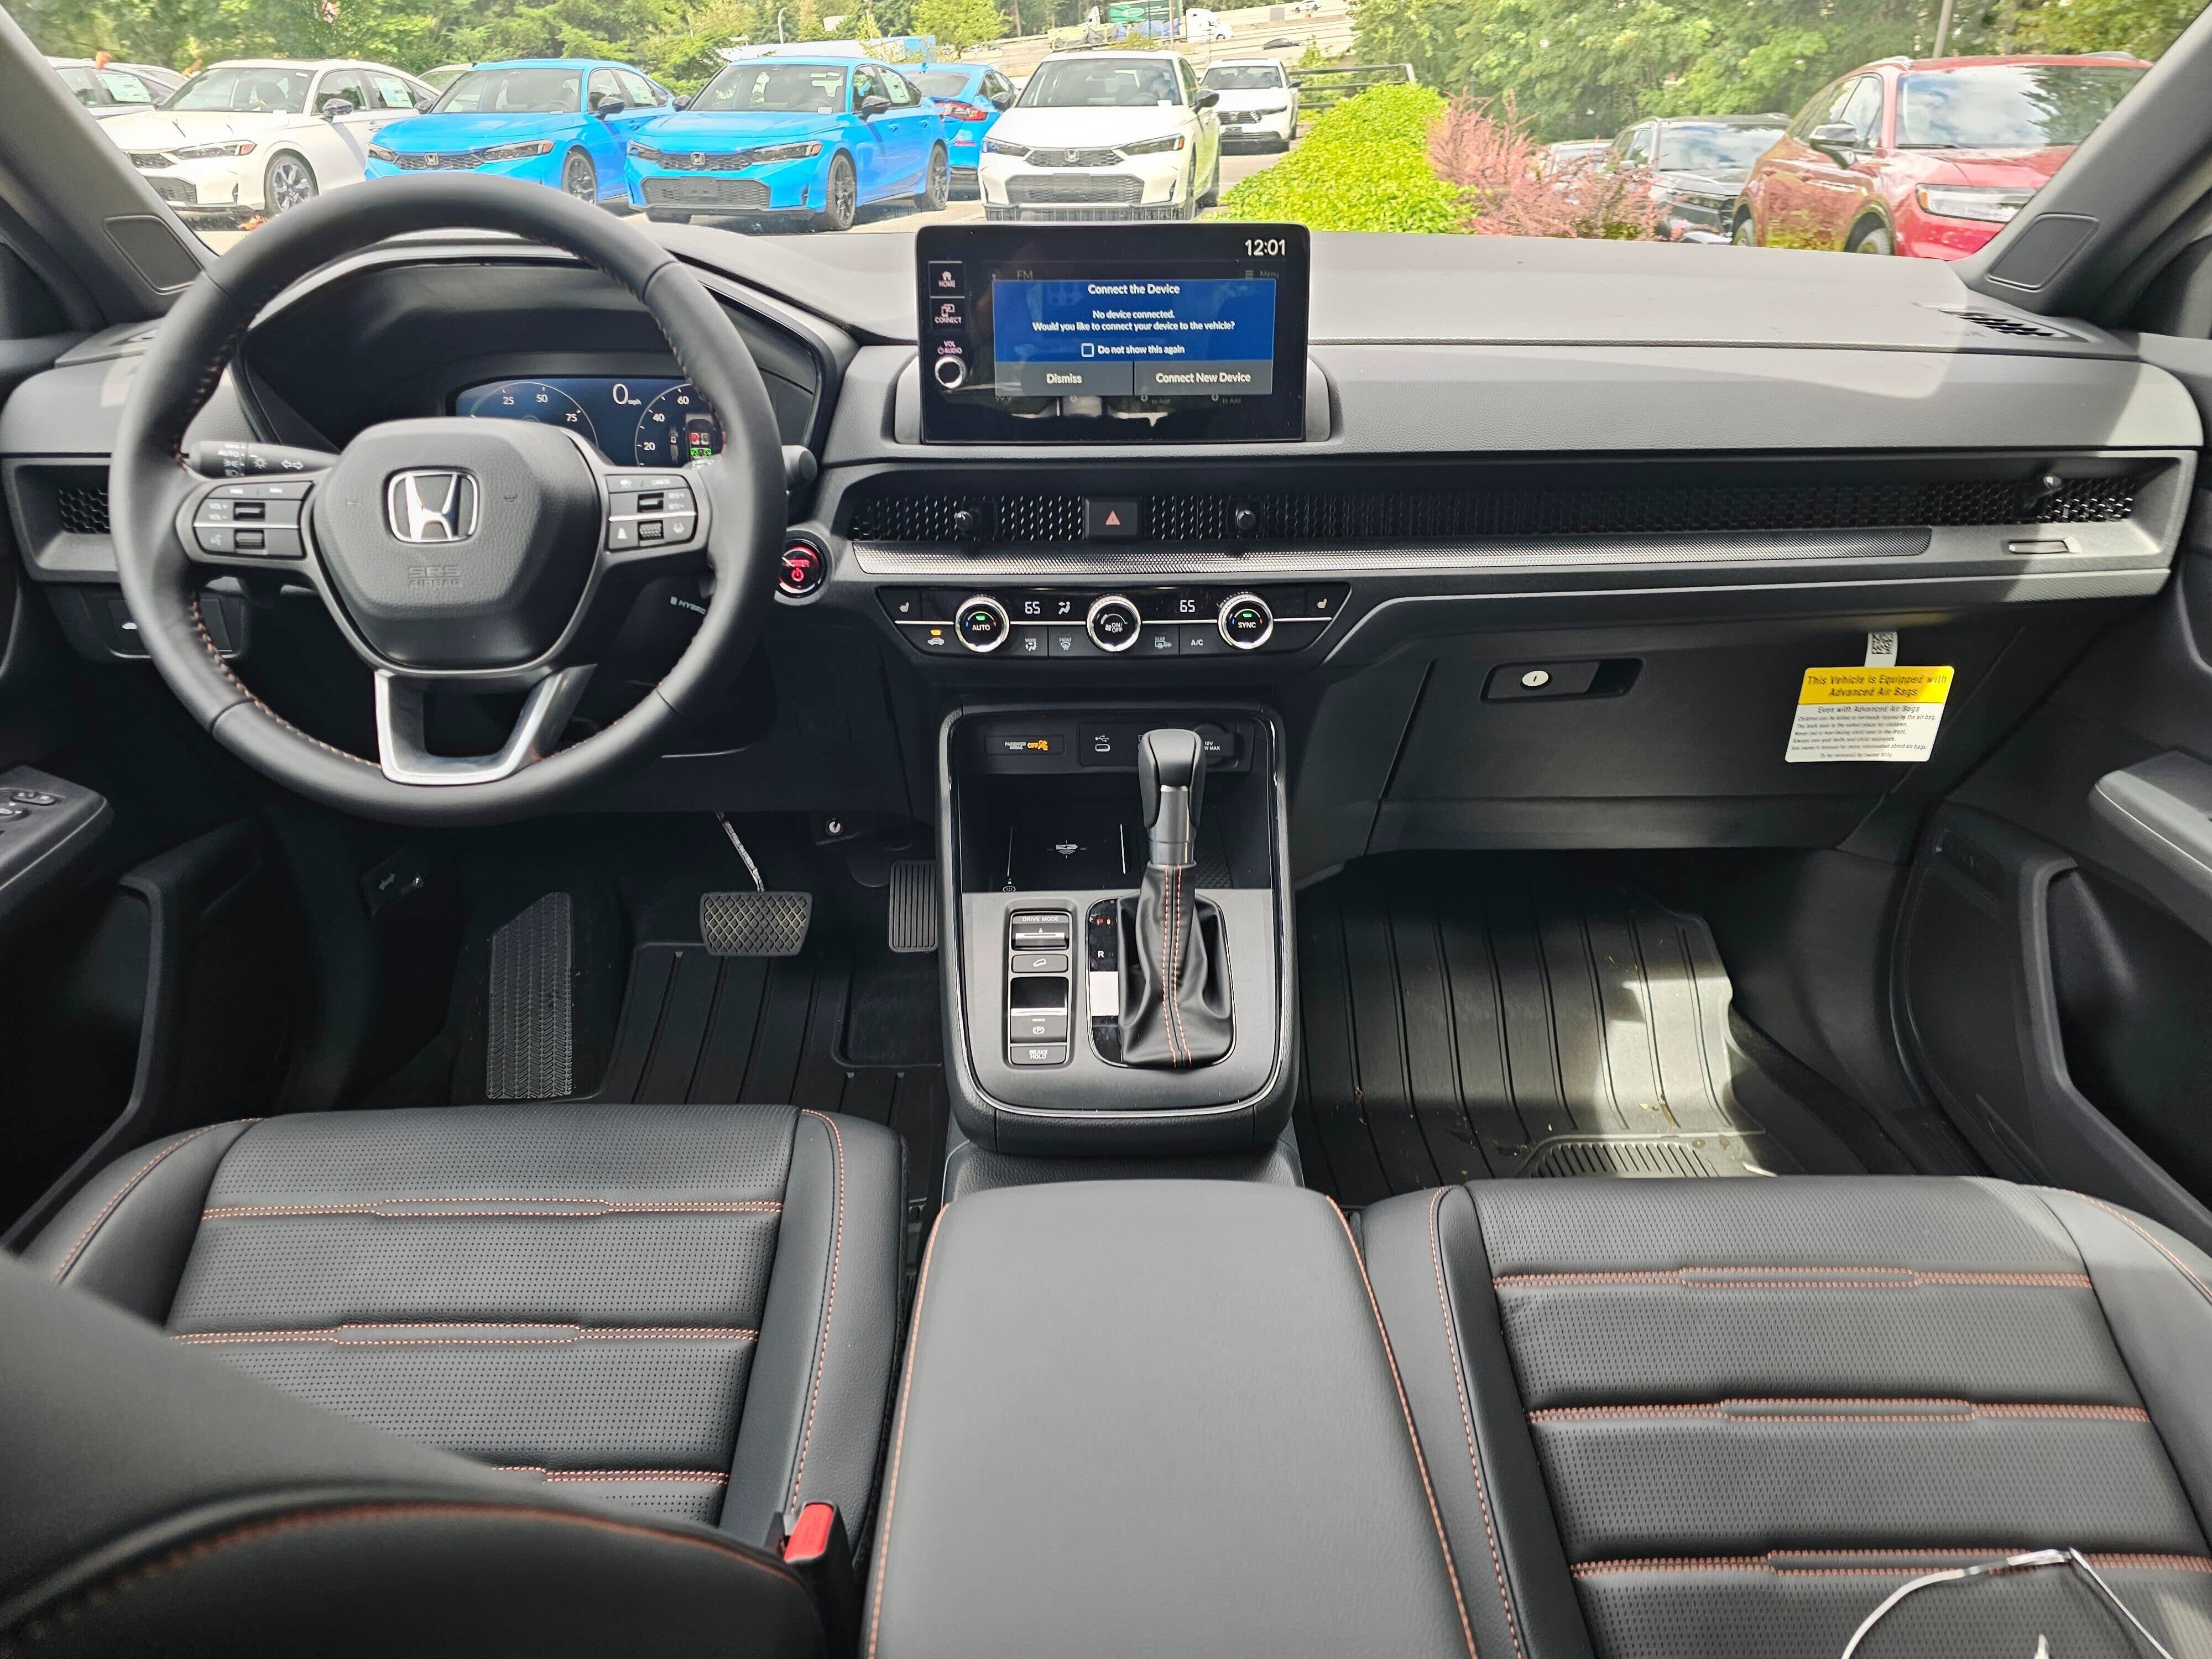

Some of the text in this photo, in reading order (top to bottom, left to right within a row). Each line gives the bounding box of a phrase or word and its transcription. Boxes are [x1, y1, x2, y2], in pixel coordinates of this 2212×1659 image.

[1245, 239, 1286, 256] 12:01
[938, 280, 956, 288] HOME
[1088, 283, 1180, 295] Connect the Device
[1092, 309, 1176, 319] No device connected.
[1032, 321, 1235, 332] Would you like to connect your device to the vehicle?
[944, 347, 963, 355] AUDIO
[1097, 345, 1185, 355] Do not show this again
[1046, 373, 1082, 384] Dismiss
[1156, 372, 1251, 383] Connect New Device
[536, 394, 548, 403] 50
[613, 383, 629, 405] 0
[503, 397, 515, 405] 25
[677, 396, 690, 405] 60
[565, 414, 578, 422] 75
[653, 413, 665, 422] 40
[643, 442, 656, 451] 20
[1025, 601, 1041, 614] 65
[1180, 599, 1196, 613] 65
[1808, 674, 1947, 686] This Vehicle is Equipped with
[1829, 687, 1918, 698] Advanced Air Bags
[1902, 705, 1920, 713] Bags
[1097, 950, 1104, 958] R
